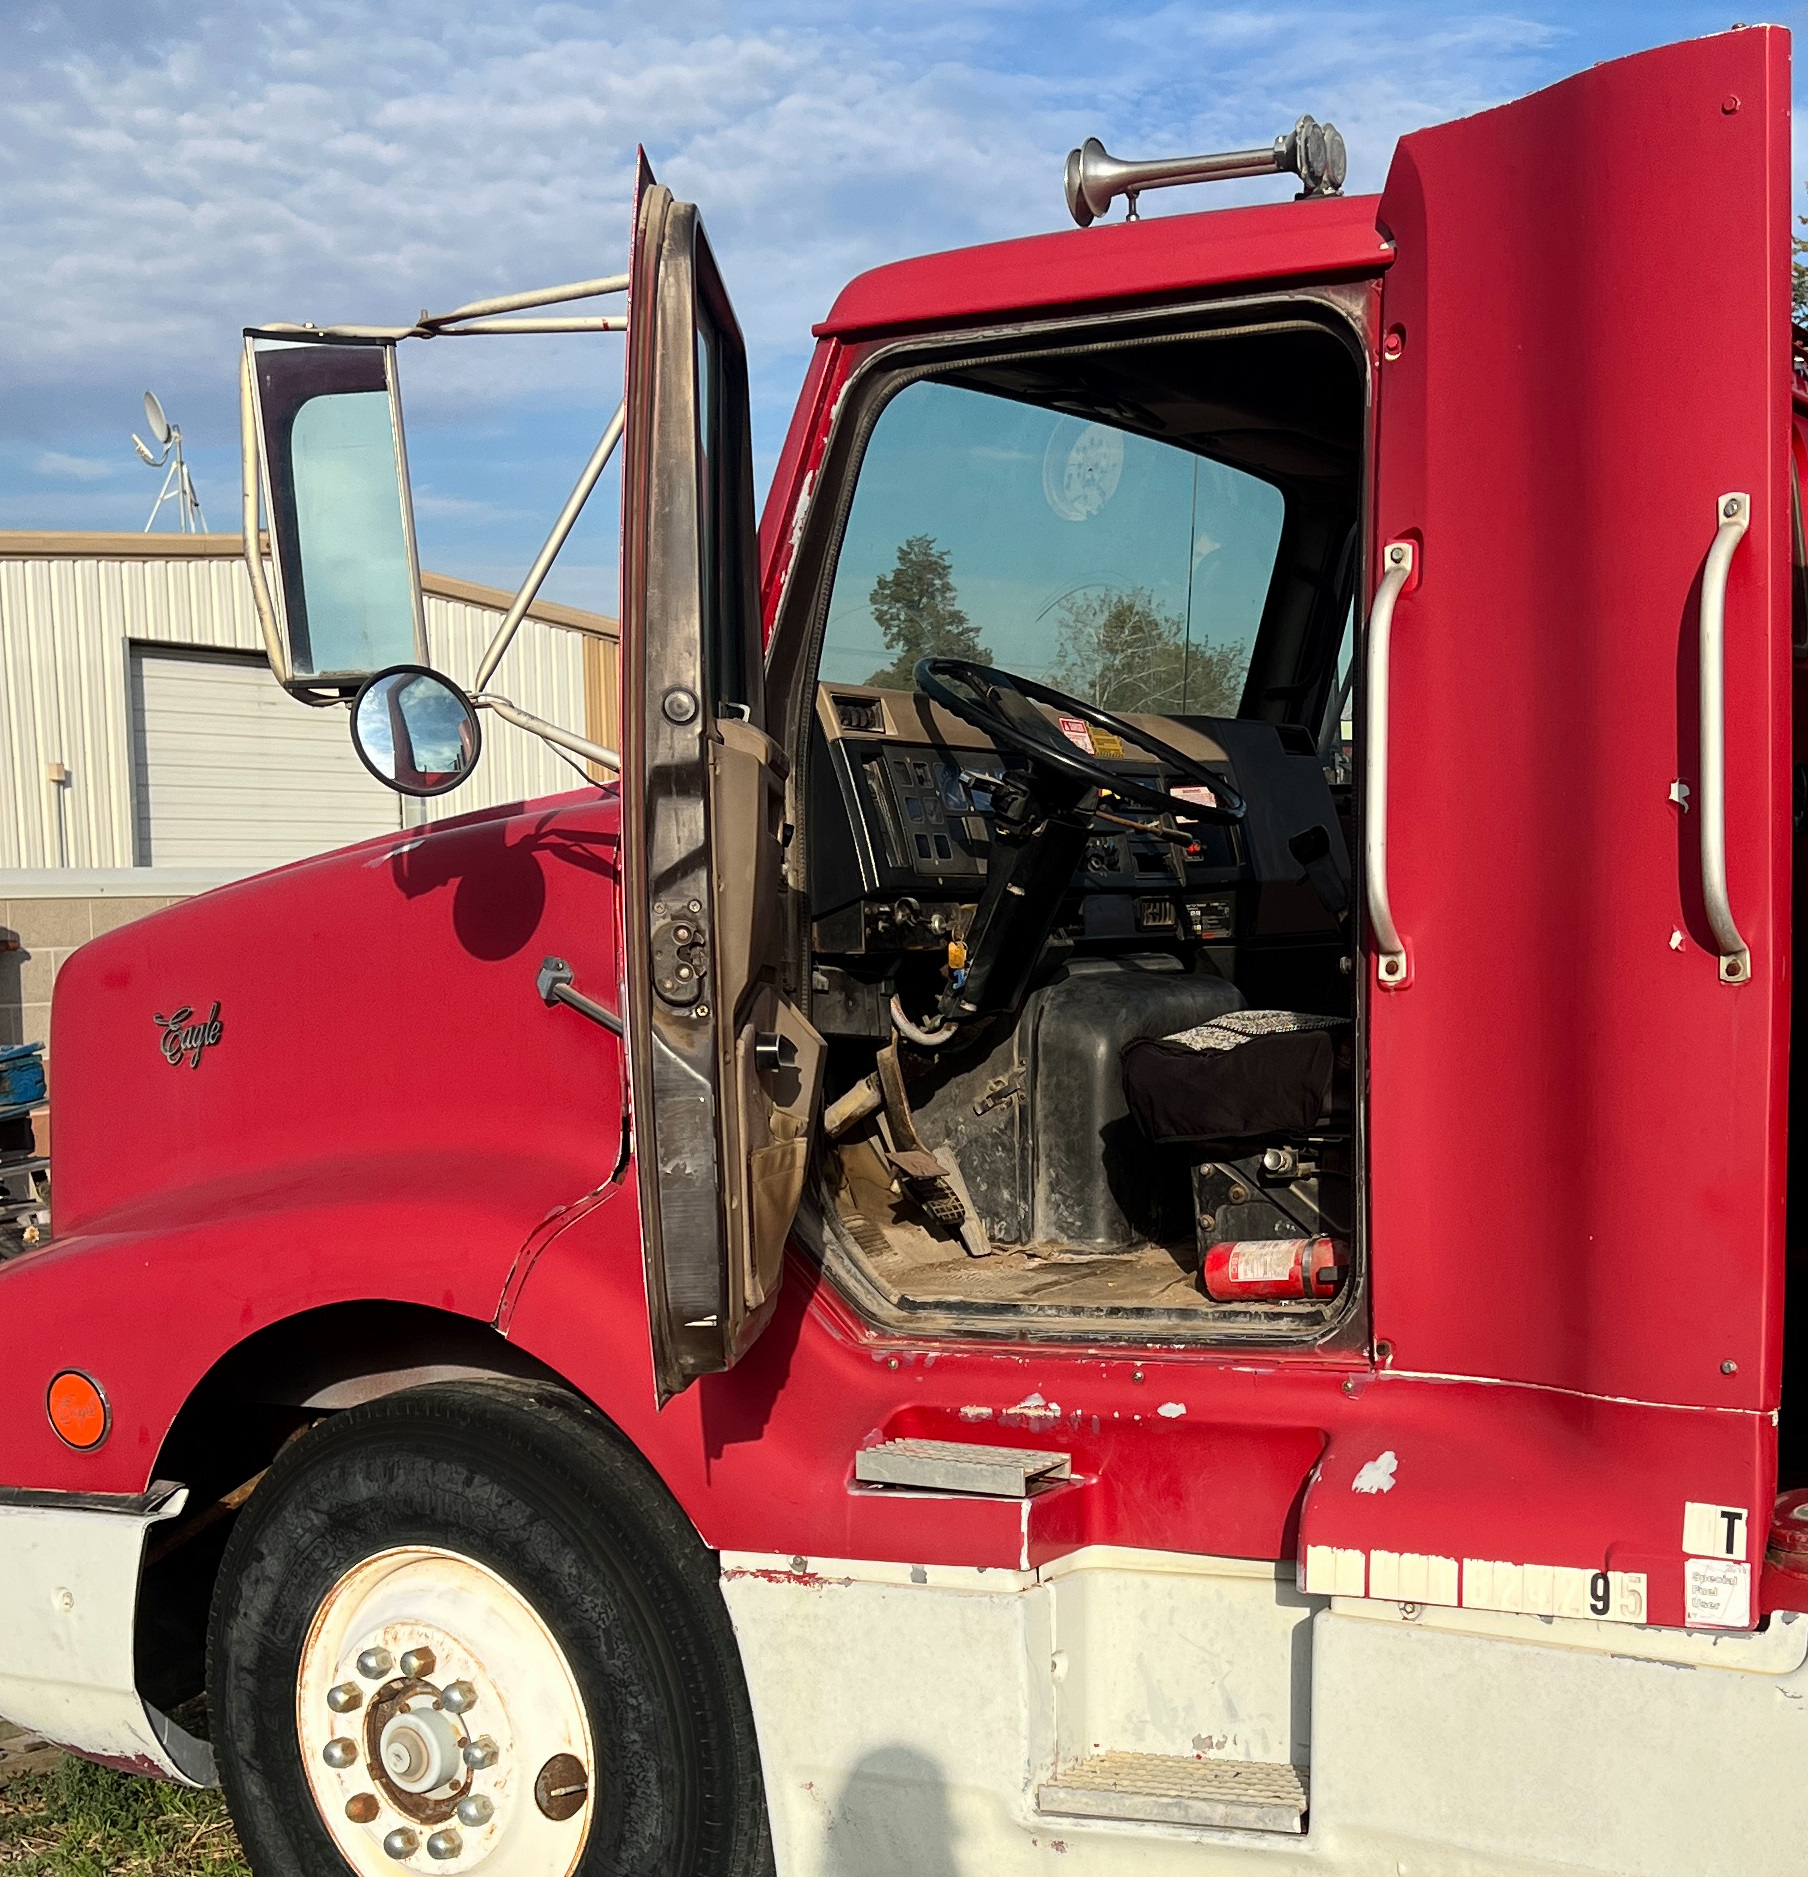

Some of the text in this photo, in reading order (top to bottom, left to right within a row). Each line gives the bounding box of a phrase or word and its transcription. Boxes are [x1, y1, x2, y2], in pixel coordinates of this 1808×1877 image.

[153, 1001, 222, 1069] Eagle
[1720, 1510, 1743, 1555] T
[1691, 1571, 1738, 1587] Special
[1691, 1585, 1718, 1598] Fuel
[1691, 1597, 1721, 1611] User
